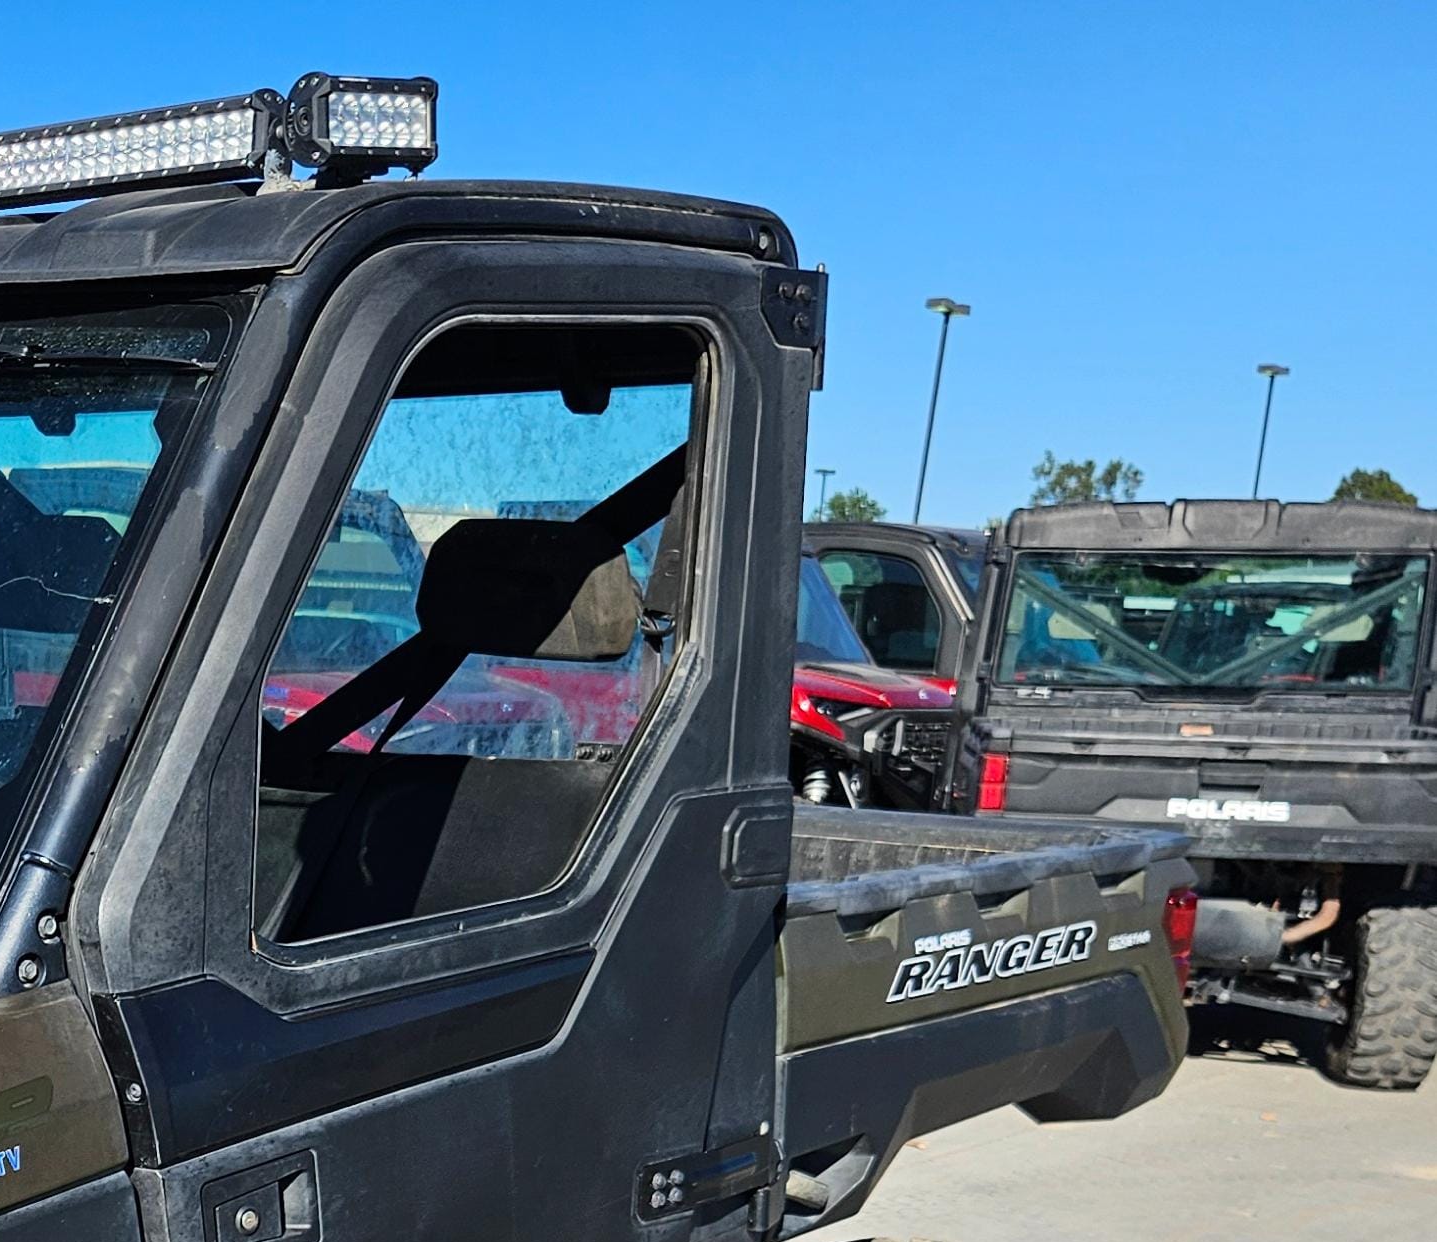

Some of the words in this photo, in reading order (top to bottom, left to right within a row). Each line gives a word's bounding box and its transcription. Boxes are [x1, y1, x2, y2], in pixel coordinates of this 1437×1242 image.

[1167, 797, 1291, 822] POLARIS
[915, 929, 974, 955] POLARIS
[886, 920, 1097, 1003] RANGER
